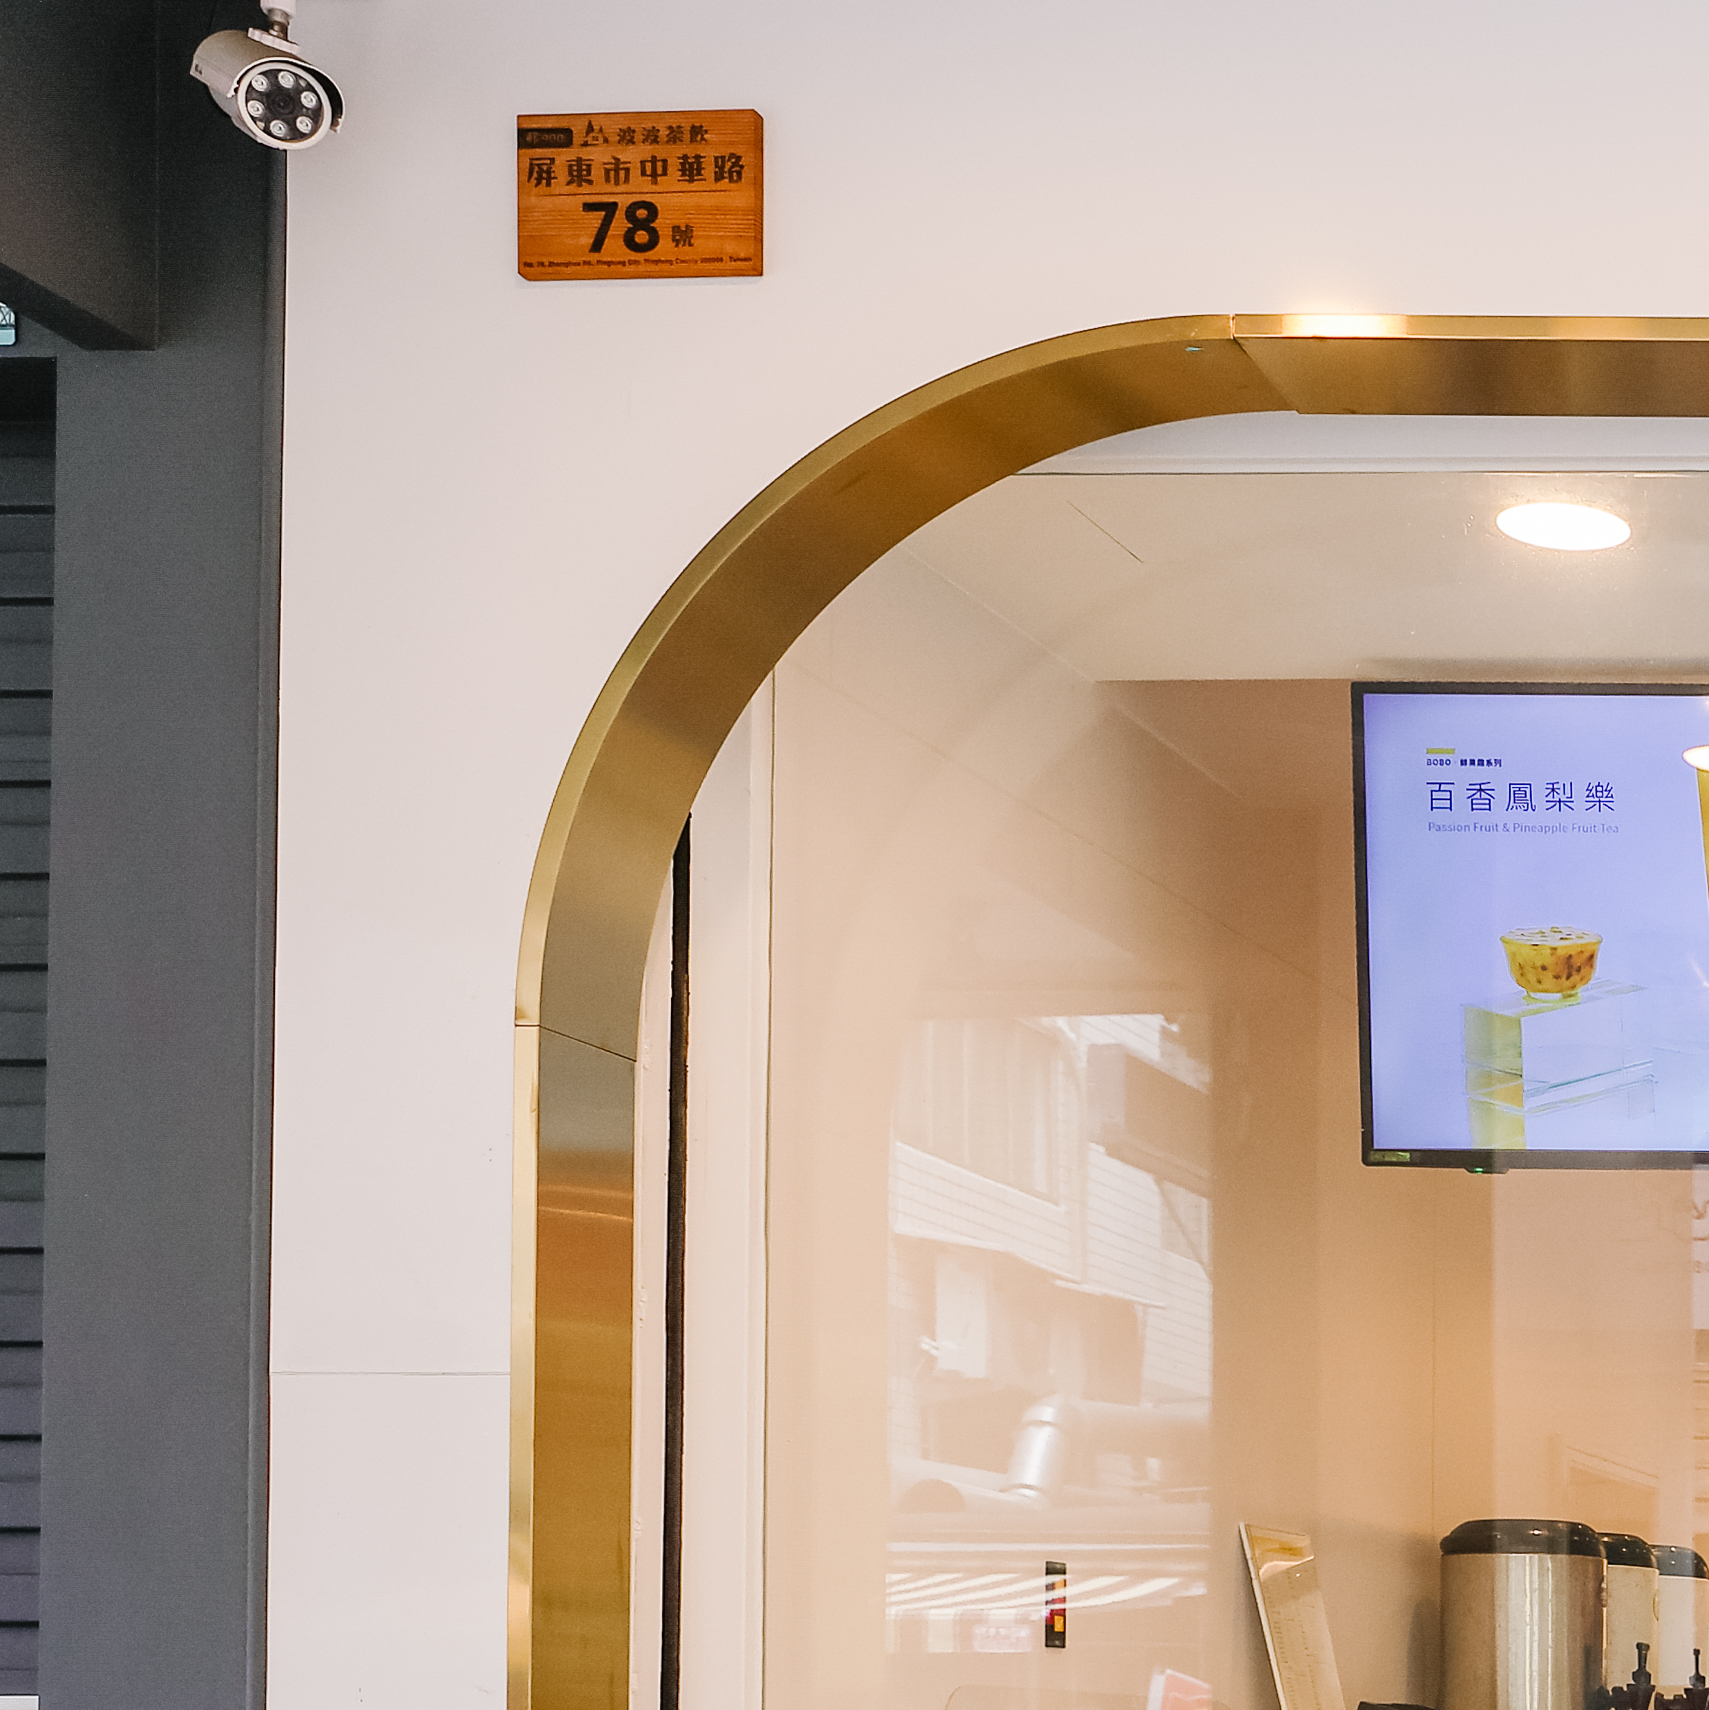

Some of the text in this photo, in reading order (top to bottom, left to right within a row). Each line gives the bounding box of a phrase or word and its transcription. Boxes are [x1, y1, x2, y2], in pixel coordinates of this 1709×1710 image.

[527, 153, 745, 188] 屏東市中華路
[582, 200, 694, 253] 78 號
[1426, 781, 1615, 813] 百香鳳梨樂
[1428, 822, 1619, 835] Passion Fruit & Pineapple Fruit Tea
